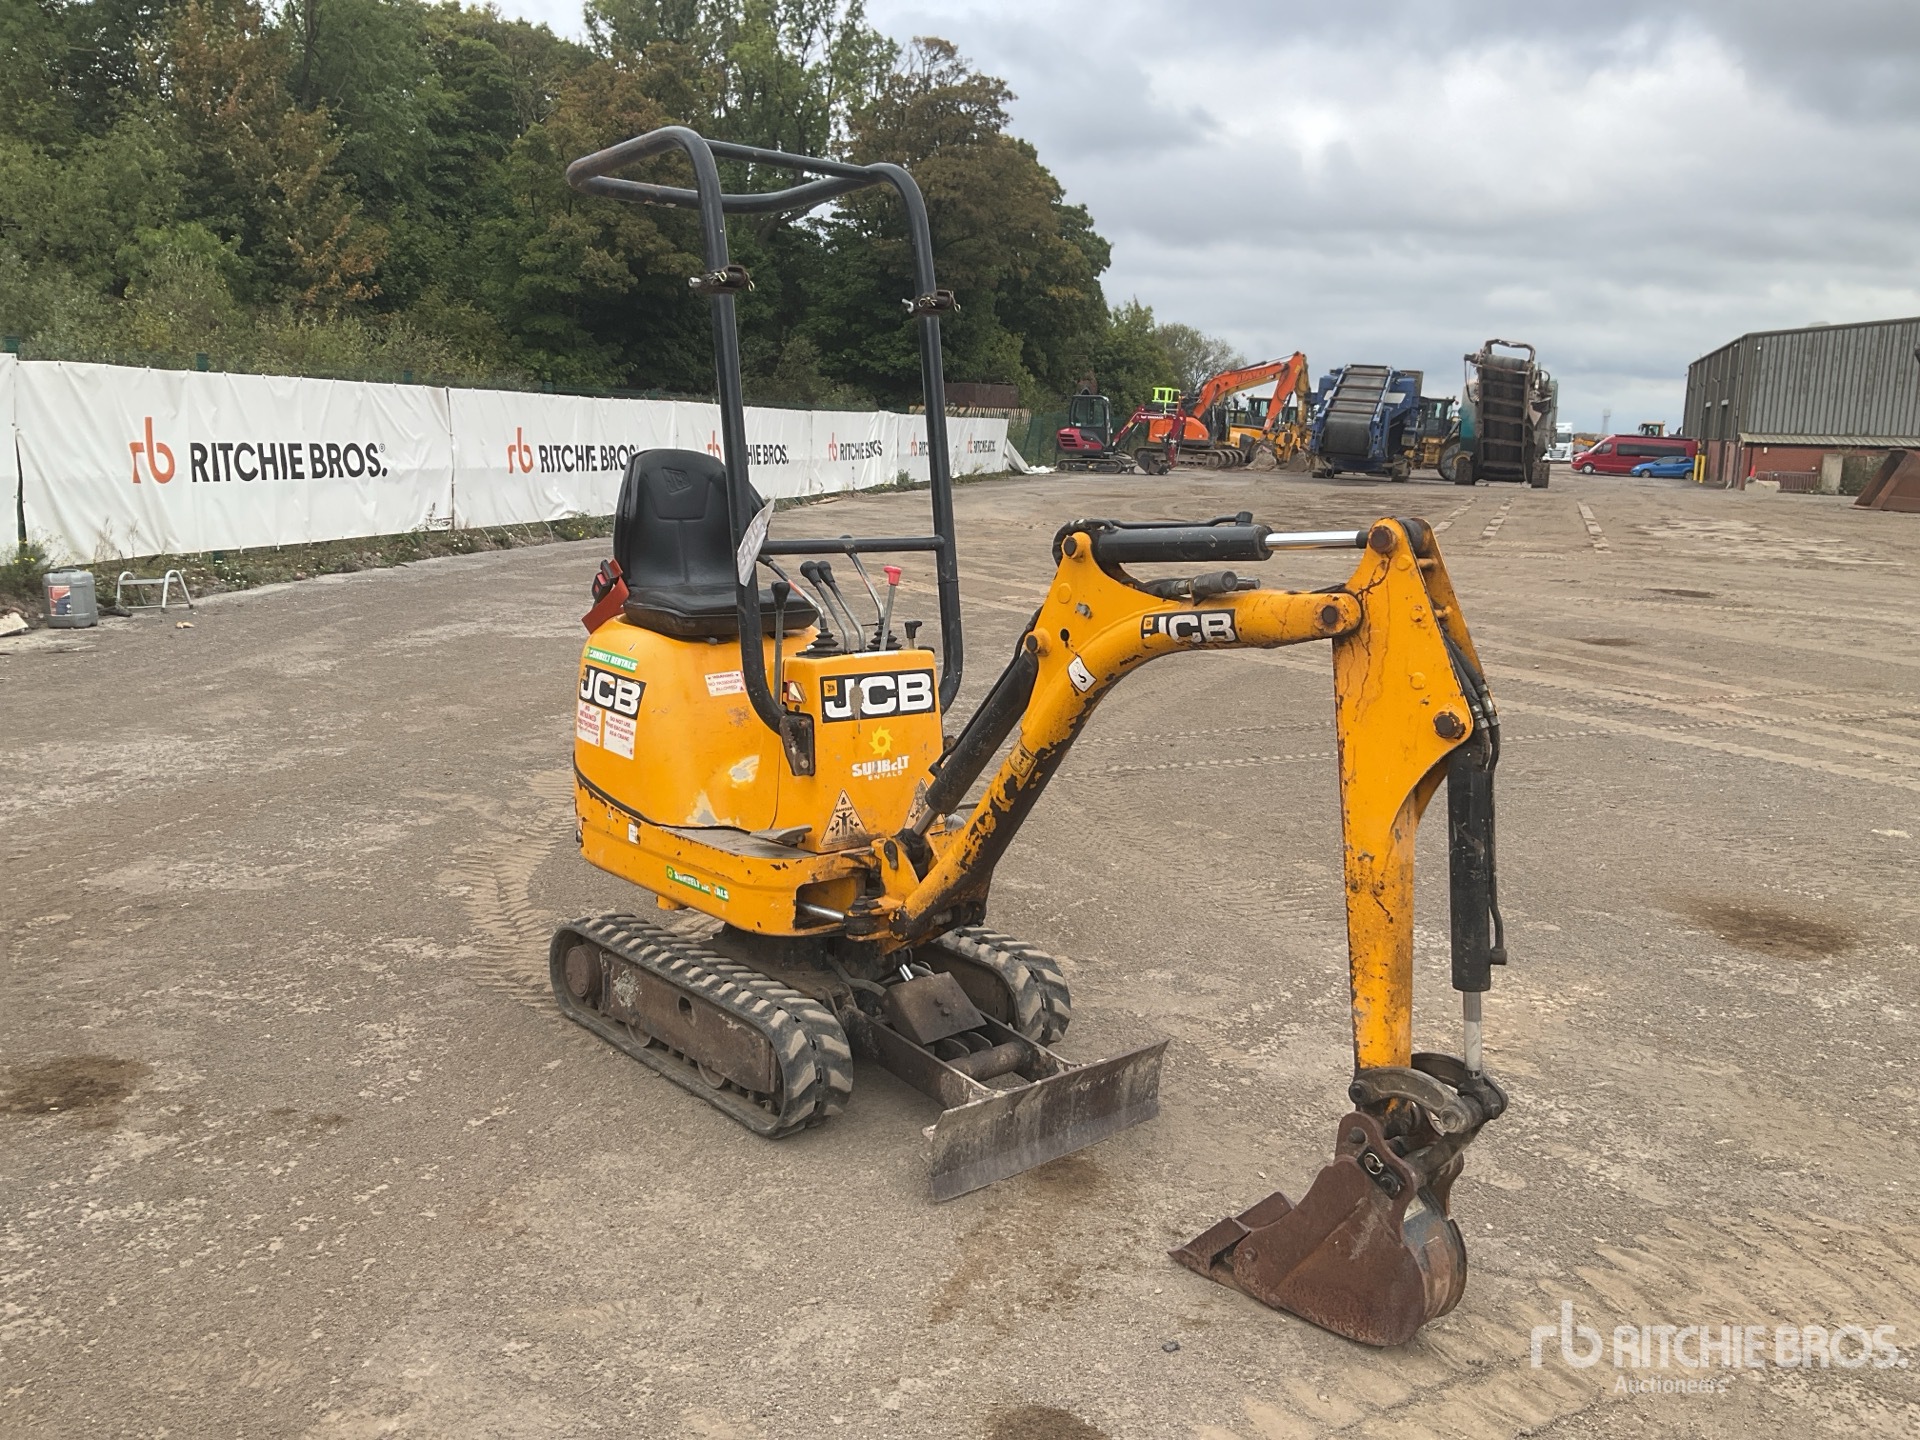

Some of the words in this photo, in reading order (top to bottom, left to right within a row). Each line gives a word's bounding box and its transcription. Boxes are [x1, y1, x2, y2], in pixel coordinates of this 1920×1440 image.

[189, 442, 306, 482] RITCHIE
[538, 444, 598, 473] RITCHIE
[840, 442, 865, 461] RITCHIE
[919, 441, 929, 456] RITC
[589, 649, 611, 662] SUNBELT
[611, 656, 638, 671] RENTALS
[580, 669, 641, 715] JCB
[823, 672, 933, 719] JCB
